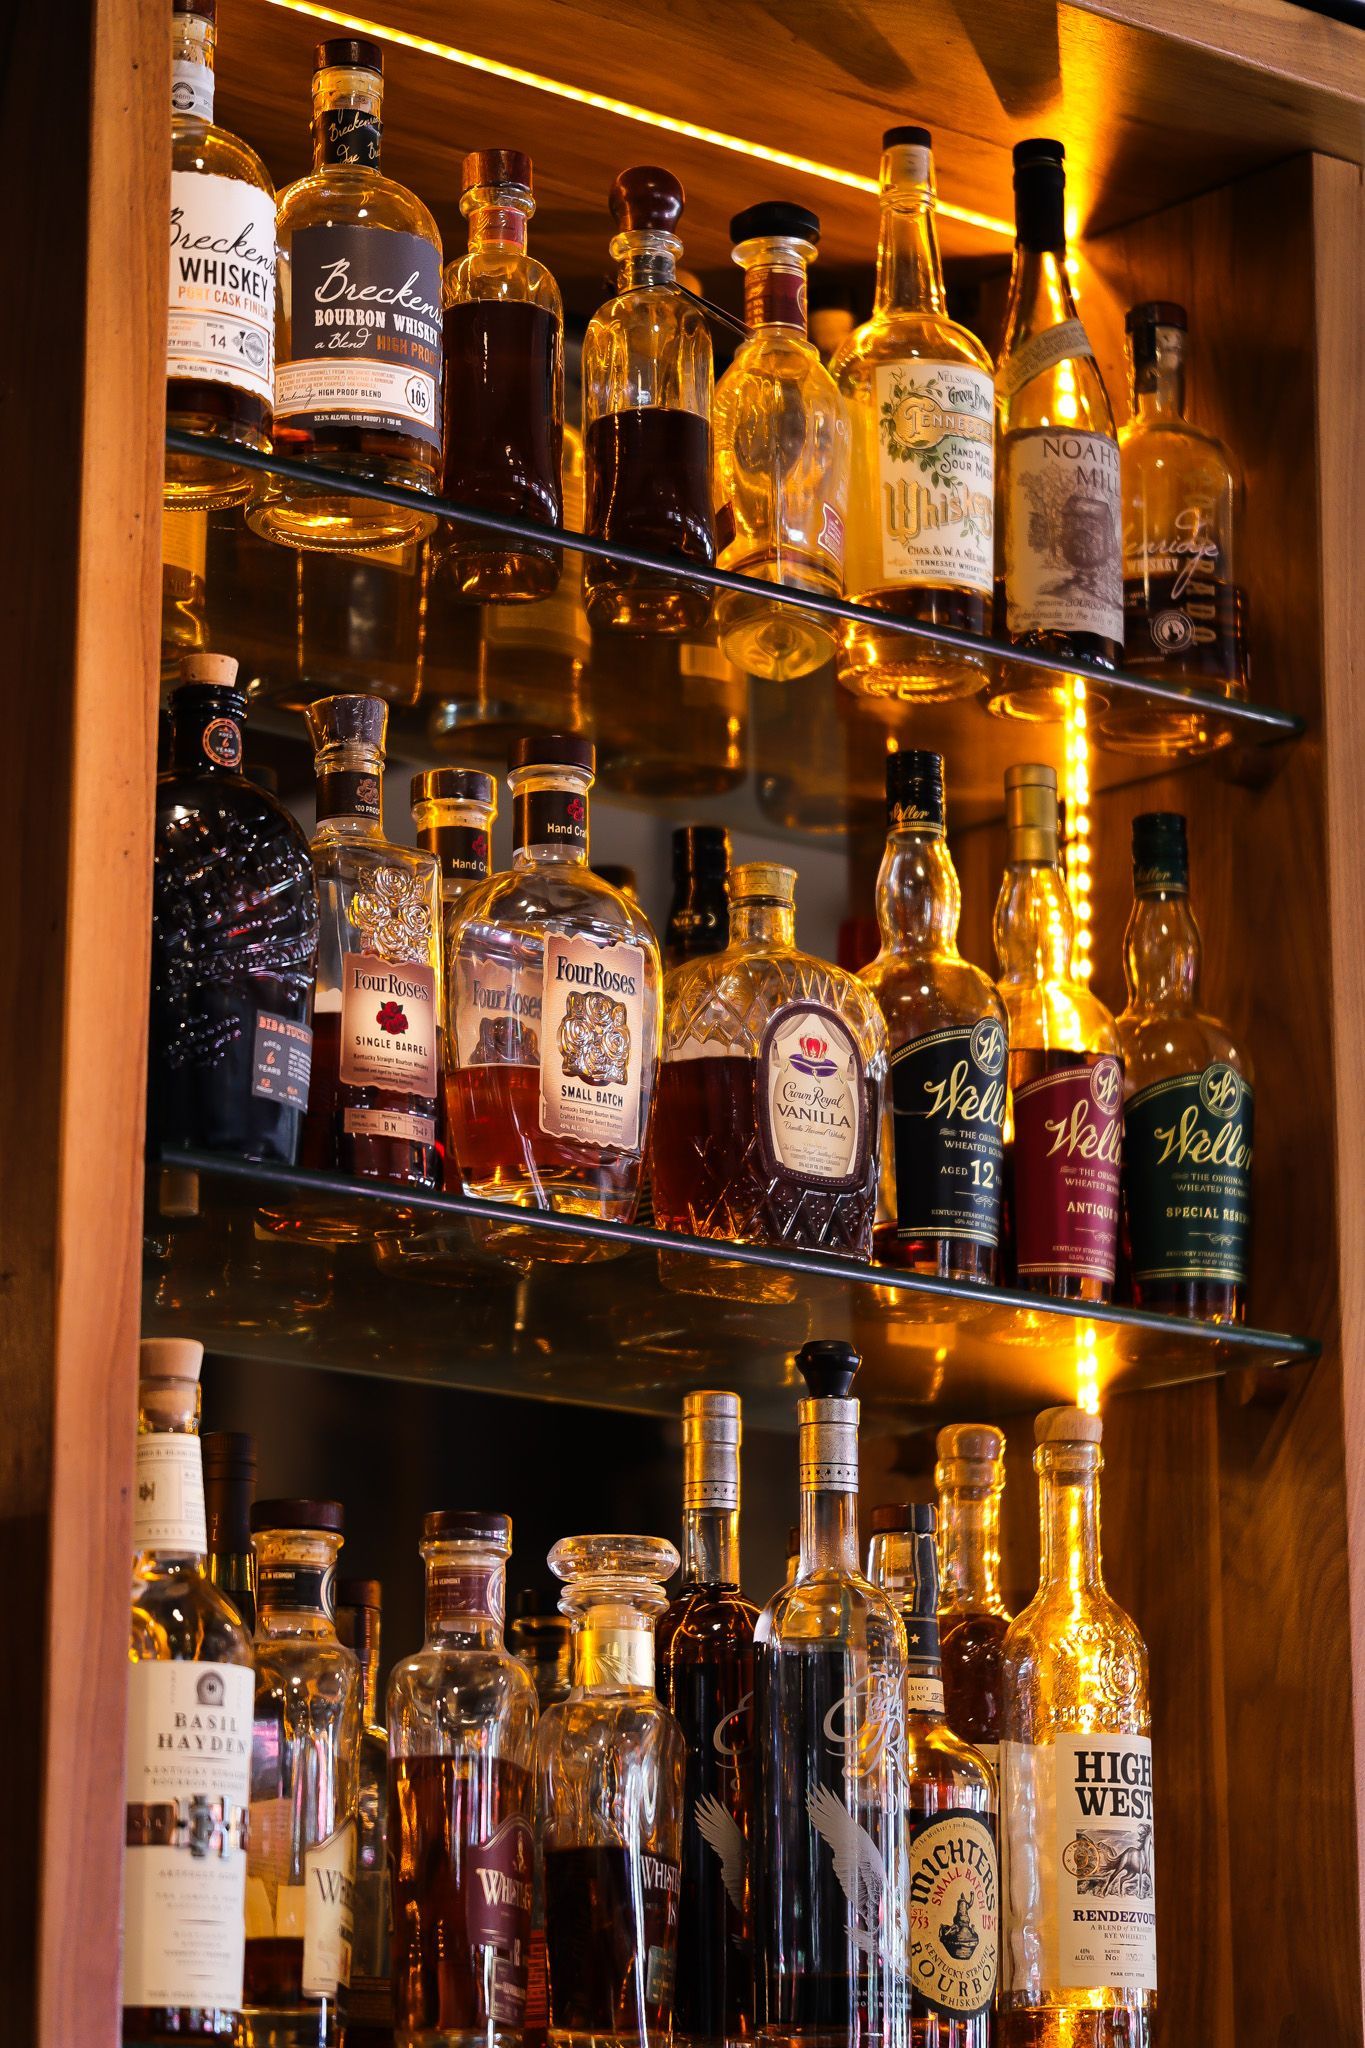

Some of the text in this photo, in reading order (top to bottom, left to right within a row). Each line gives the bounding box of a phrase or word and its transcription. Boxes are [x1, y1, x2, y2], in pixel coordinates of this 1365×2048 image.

[179, 257, 268, 303] WHISKEY
[179, 286, 269, 320] PORT CASK FINISH
[314, 308, 438, 348] BOURBON WHISKEY
[315, 328, 372, 350] a Blend
[210, 334, 226, 349] 14
[376, 335, 408, 356] HIGH
[318, 388, 382, 398] HIGH PROOF BLEND
[411, 388, 426, 408] 105
[951, 444, 975, 459] HAND
[940, 452, 972, 474] SOUR
[915, 559, 957, 569] TENNESSEE
[222, 737, 229, 748] 6
[547, 823, 572, 835] Hand
[452, 858, 477, 871] Hand
[353, 967, 429, 1000] Four Roses
[556, 955, 636, 996] Four Roses
[356, 1035, 428, 1057] SINGLE BARREL
[266, 1050, 276, 1065] 6
[561, 1084, 623, 1107] SMALL BATCH
[783, 1081, 845, 1110] Crown Royal
[776, 1103, 852, 1128] VANILLA
[960, 1129, 977, 1139] THE
[944, 1140, 987, 1153] WHEATED
[940, 1166, 968, 1175] AGED
[970, 1159, 994, 1189] 12
[1079, 1168, 1095, 1177] THE
[1191, 1173, 1209, 1181] THE
[1065, 1178, 1105, 1191] WHEATED
[1177, 1184, 1222, 1193] WHEATED
[931, 1208, 984, 1220] KENTUCKY STRAIGHT
[1166, 1207, 1219, 1219] SPECIAL
[174, 1711, 237, 1733] BASIL
[157, 1732, 248, 1754] HAYDEN
[1074, 1751, 1151, 1787] HIGH
[1075, 1786, 1152, 1819] WEST
[911, 1837, 996, 1912] MICHTER'S
[931, 1866, 986, 1910] SMALL BATCH
[911, 1940, 997, 1997] BOURBON
[924, 1942, 990, 1980] KENTUCKY STRAIGHT
[940, 1993, 980, 2007] WHISKEY
